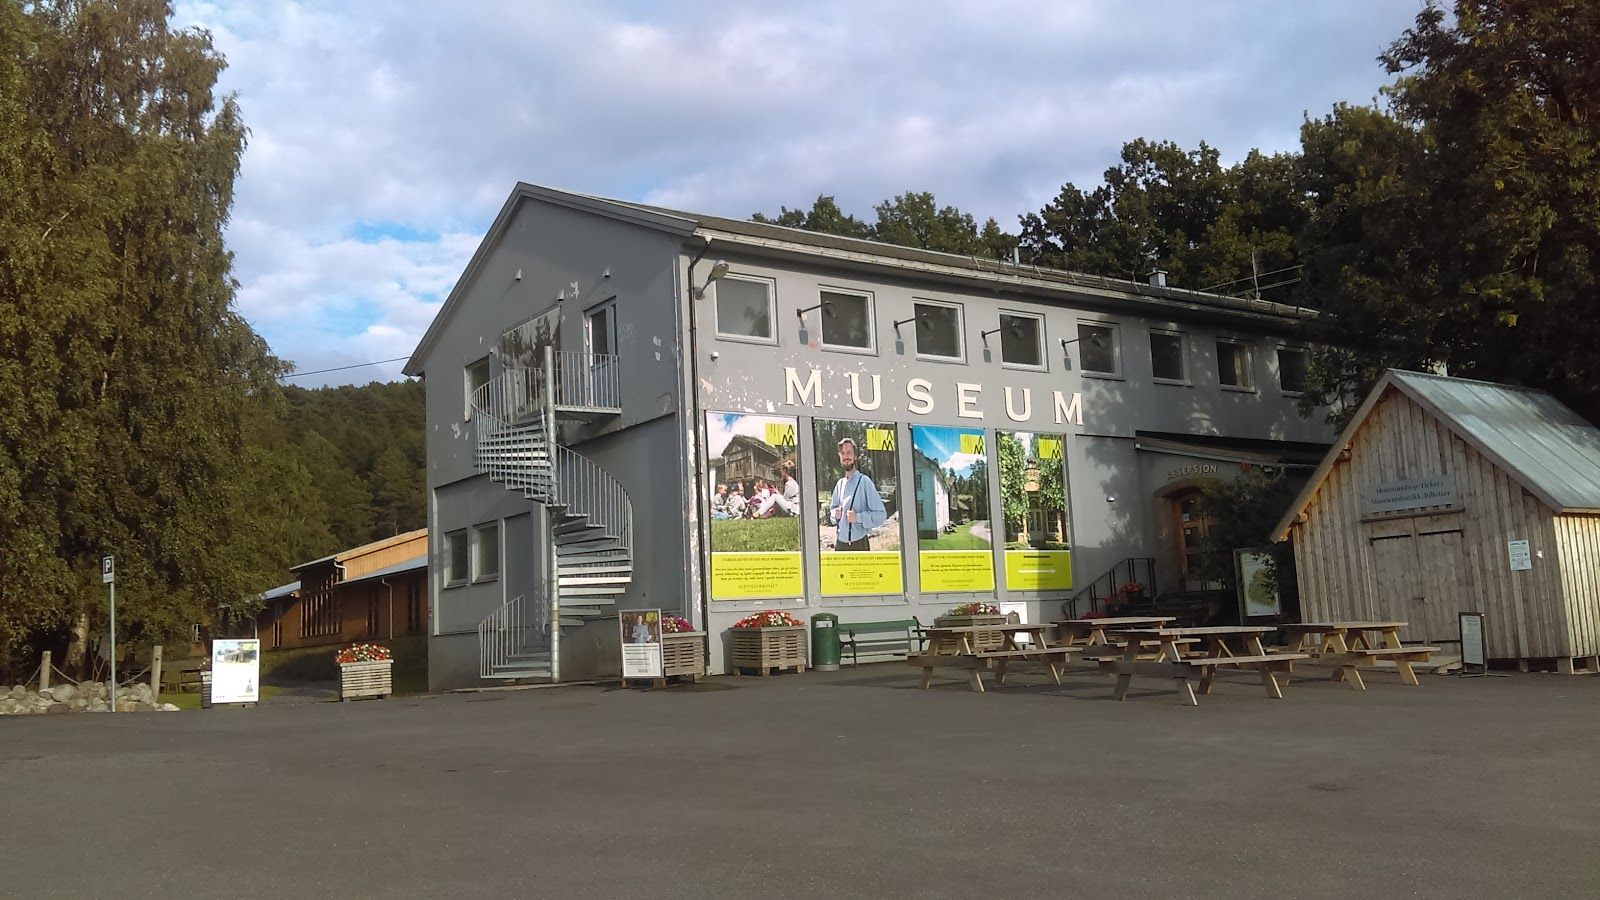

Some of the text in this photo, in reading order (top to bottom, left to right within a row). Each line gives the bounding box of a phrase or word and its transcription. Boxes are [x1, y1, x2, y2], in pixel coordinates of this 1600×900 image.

[784, 366, 1084, 426] MUSEUM
[1166, 463, 1218, 480] RESEPSJON
[105, 559, 111, 572] P
